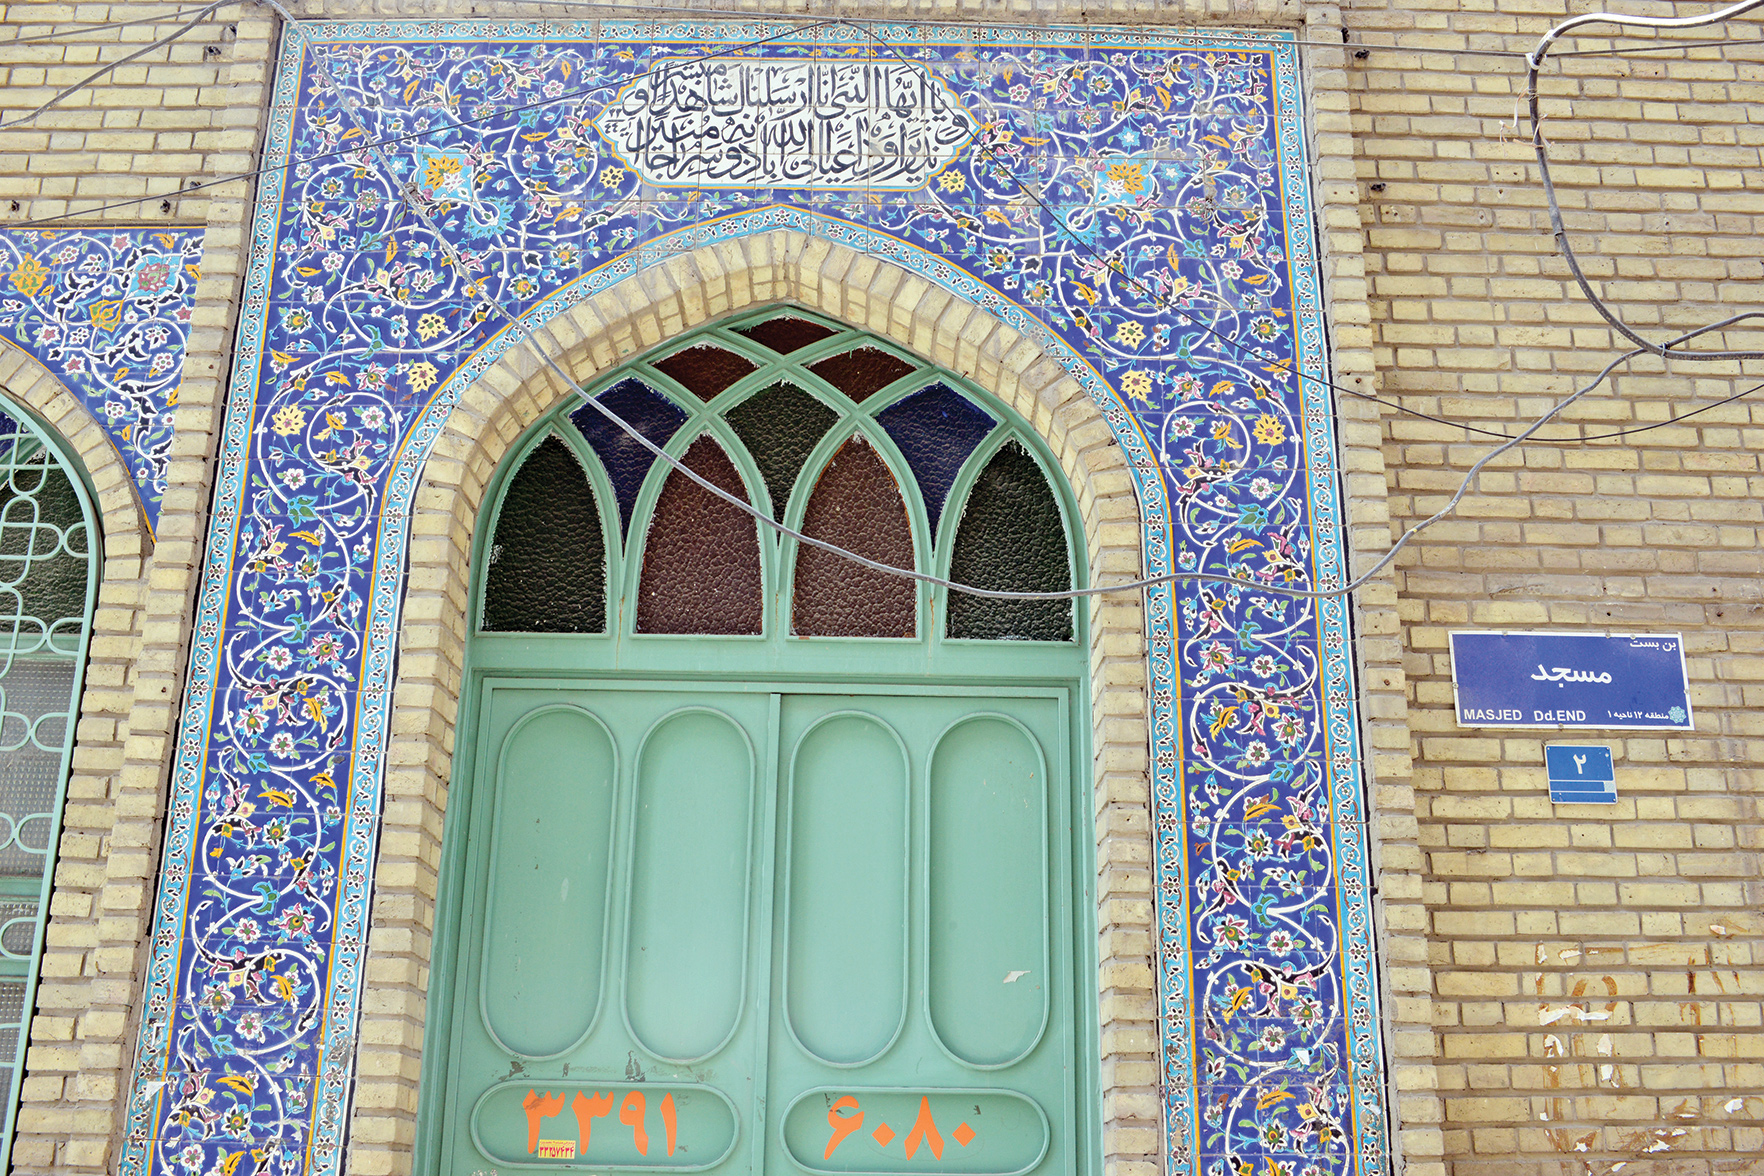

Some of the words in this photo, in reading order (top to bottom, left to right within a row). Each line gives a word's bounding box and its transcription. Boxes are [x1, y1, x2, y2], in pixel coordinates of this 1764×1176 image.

[1629, 640, 1660, 651] بست
[1662, 641, 1677, 652] بن
[1530, 663, 1613, 688] مسجد
[1463, 708, 1523, 721] MASJED
[1644, 711, 1669, 719] منطقه
[1572, 753, 1587, 775] ۲
[522, 1088, 677, 1157] ۳۳۹۱
[824, 1095, 976, 1161] ۶۰۸۰
